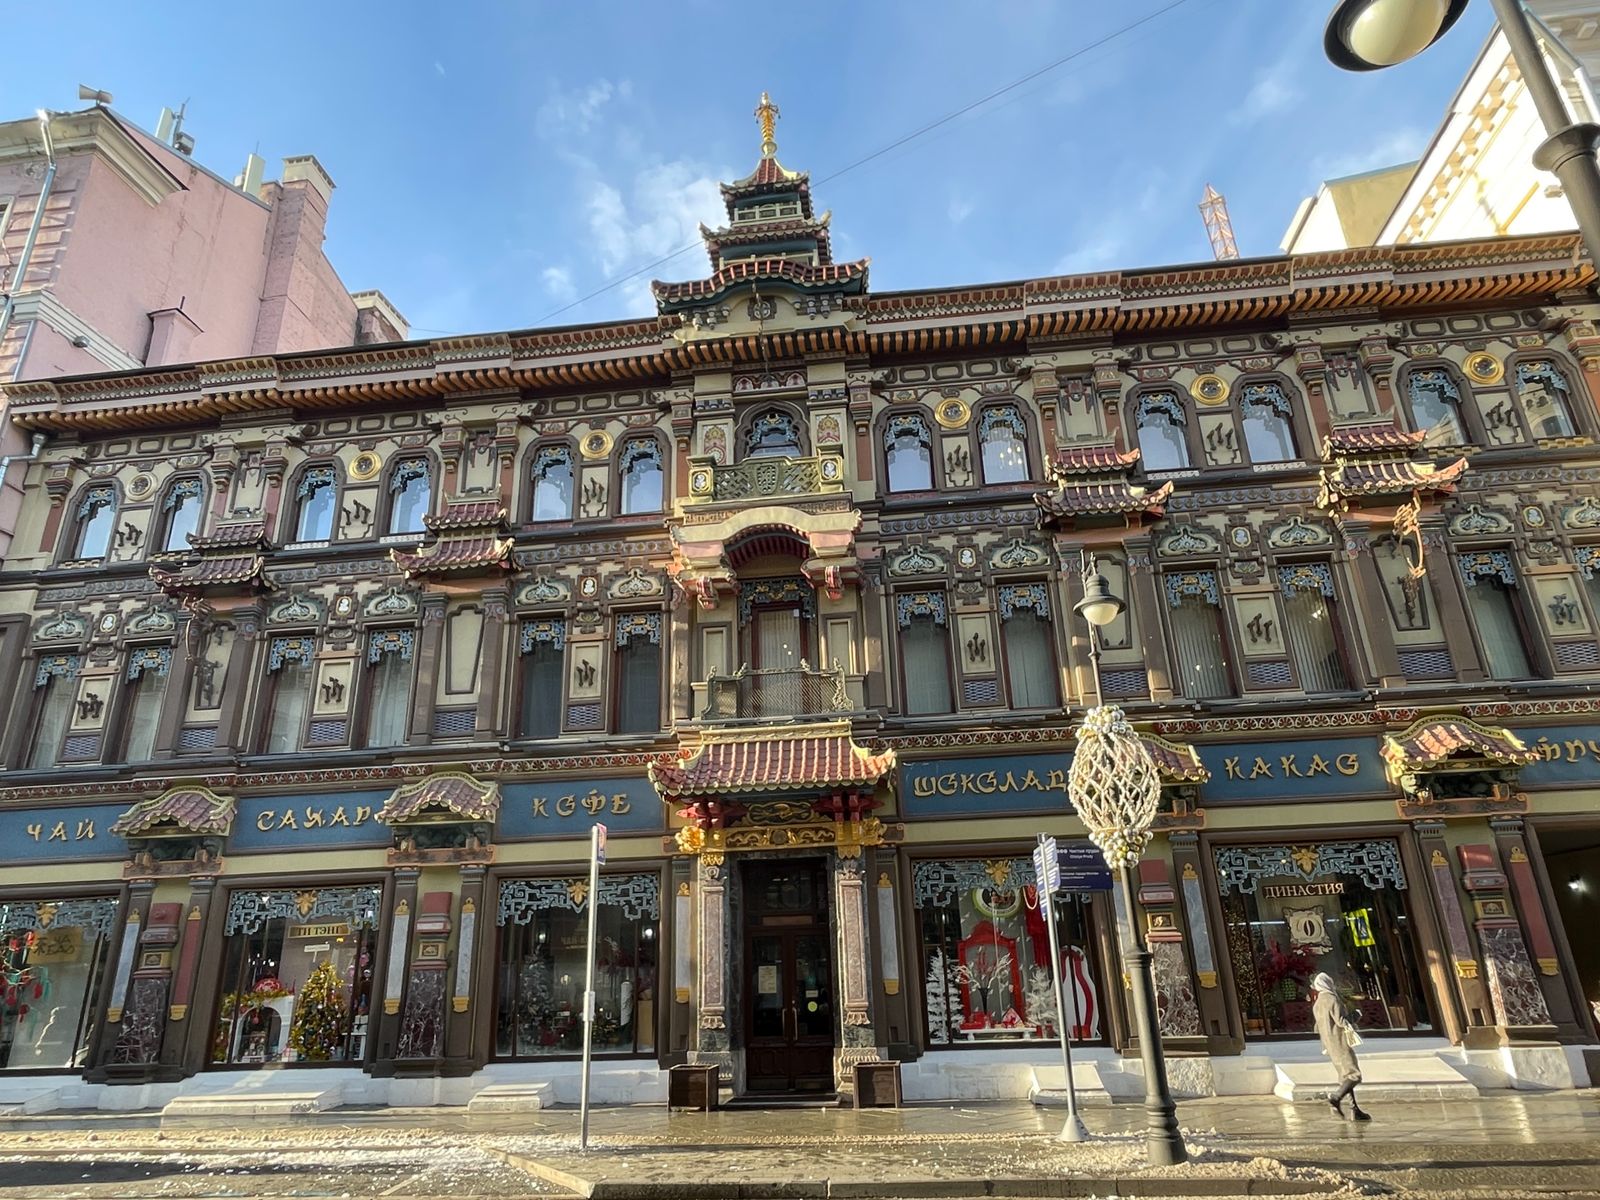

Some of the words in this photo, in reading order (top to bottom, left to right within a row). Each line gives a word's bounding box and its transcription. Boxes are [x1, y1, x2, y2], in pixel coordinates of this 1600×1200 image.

[1224, 753, 1360, 780] КАКАО
[914, 769, 1067, 797] ШОКОЛАД
[532, 789, 631, 817] КОФЕ
[27, 818, 96, 841] ЧАЙ
[257, 806, 371, 831] САХАР
[1263, 882, 1345, 899] ДИНАСТИЯ
